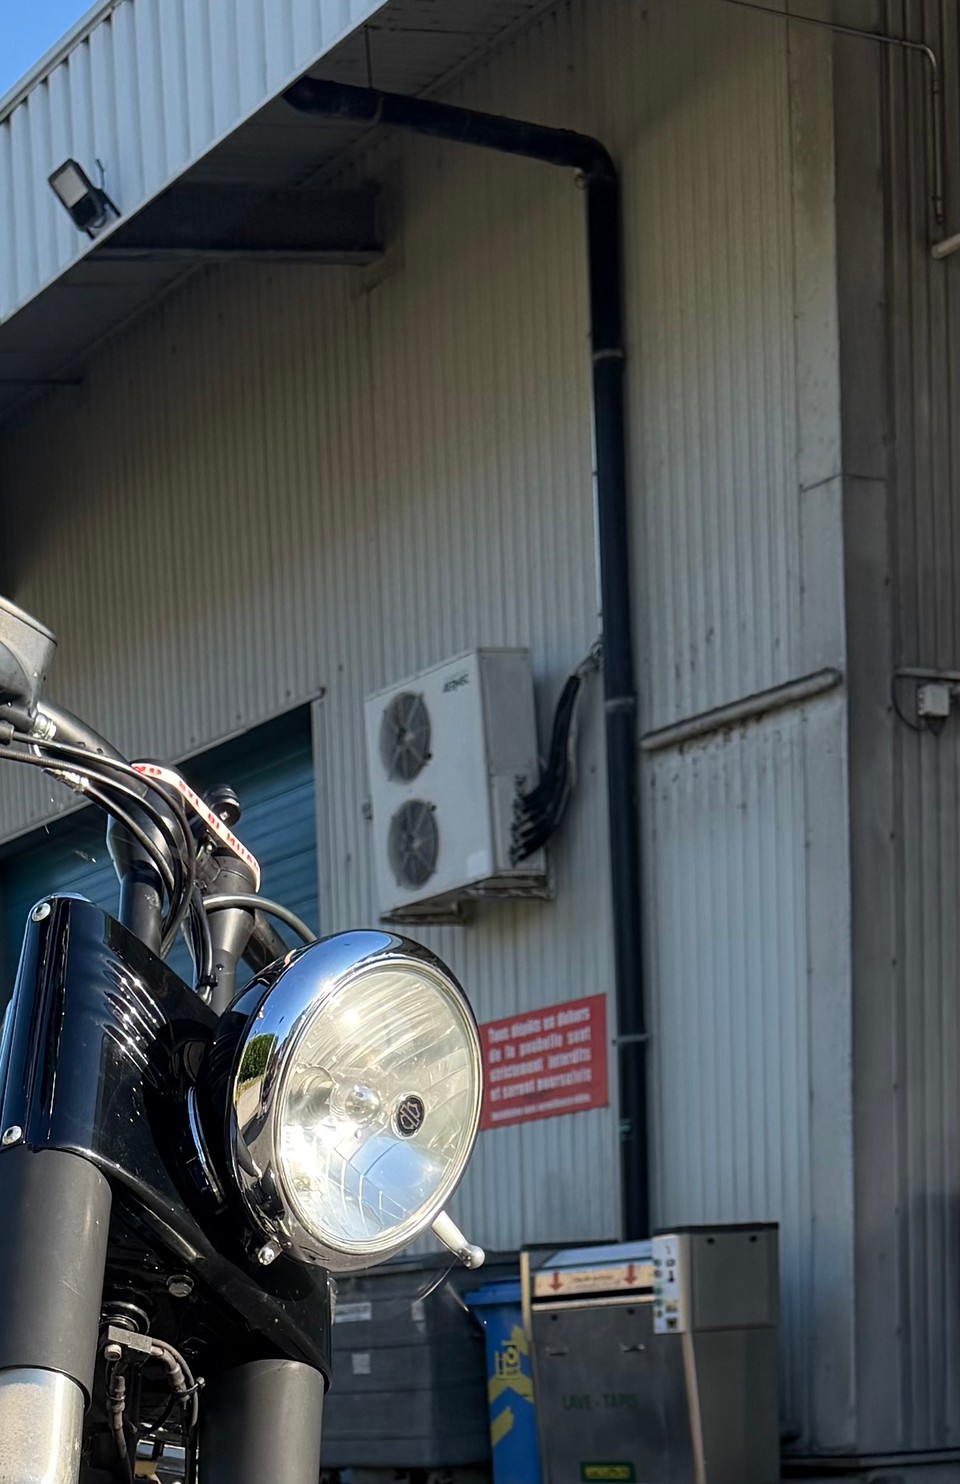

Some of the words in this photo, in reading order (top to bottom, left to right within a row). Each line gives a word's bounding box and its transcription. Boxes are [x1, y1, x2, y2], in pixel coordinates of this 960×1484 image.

[489, 1048, 501, 1064] de
[504, 1045, 515, 1059] la
[519, 1033, 563, 1057] poubelle
[547, 1047, 591, 1070] interdits
[490, 1087, 501, 1102] et
